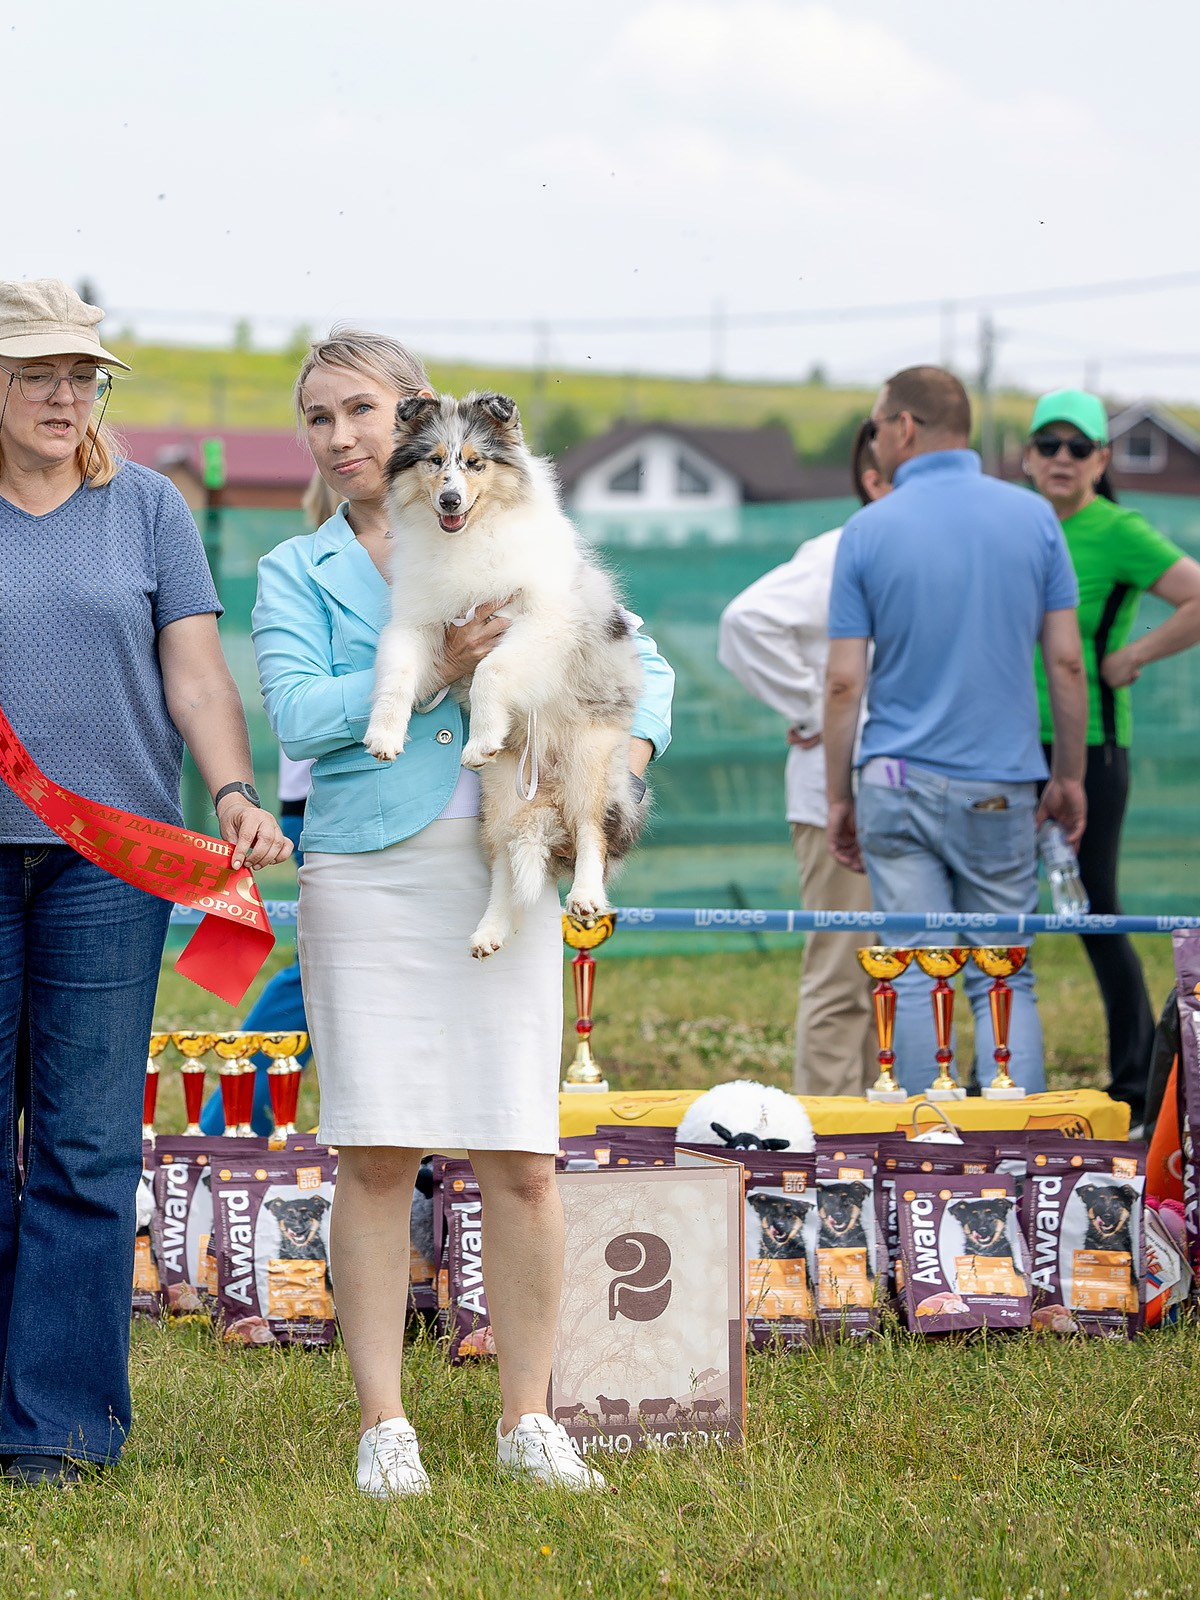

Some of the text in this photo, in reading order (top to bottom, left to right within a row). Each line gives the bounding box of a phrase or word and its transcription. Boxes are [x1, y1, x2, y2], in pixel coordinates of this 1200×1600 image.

[54, 789, 122, 824] КОЛЛИ
[125, 818, 234, 857] ДЛИННОШЁ
[54, 824, 177, 897] ПАСТУШЬИХ
[185, 891, 258, 924] ПОРОД
[160, 1164, 189, 1274] Award
[218, 1189, 253, 1305] Award
[1030, 1175, 1062, 1293] Award
[569, 1434, 632, 1455] АНЧО
